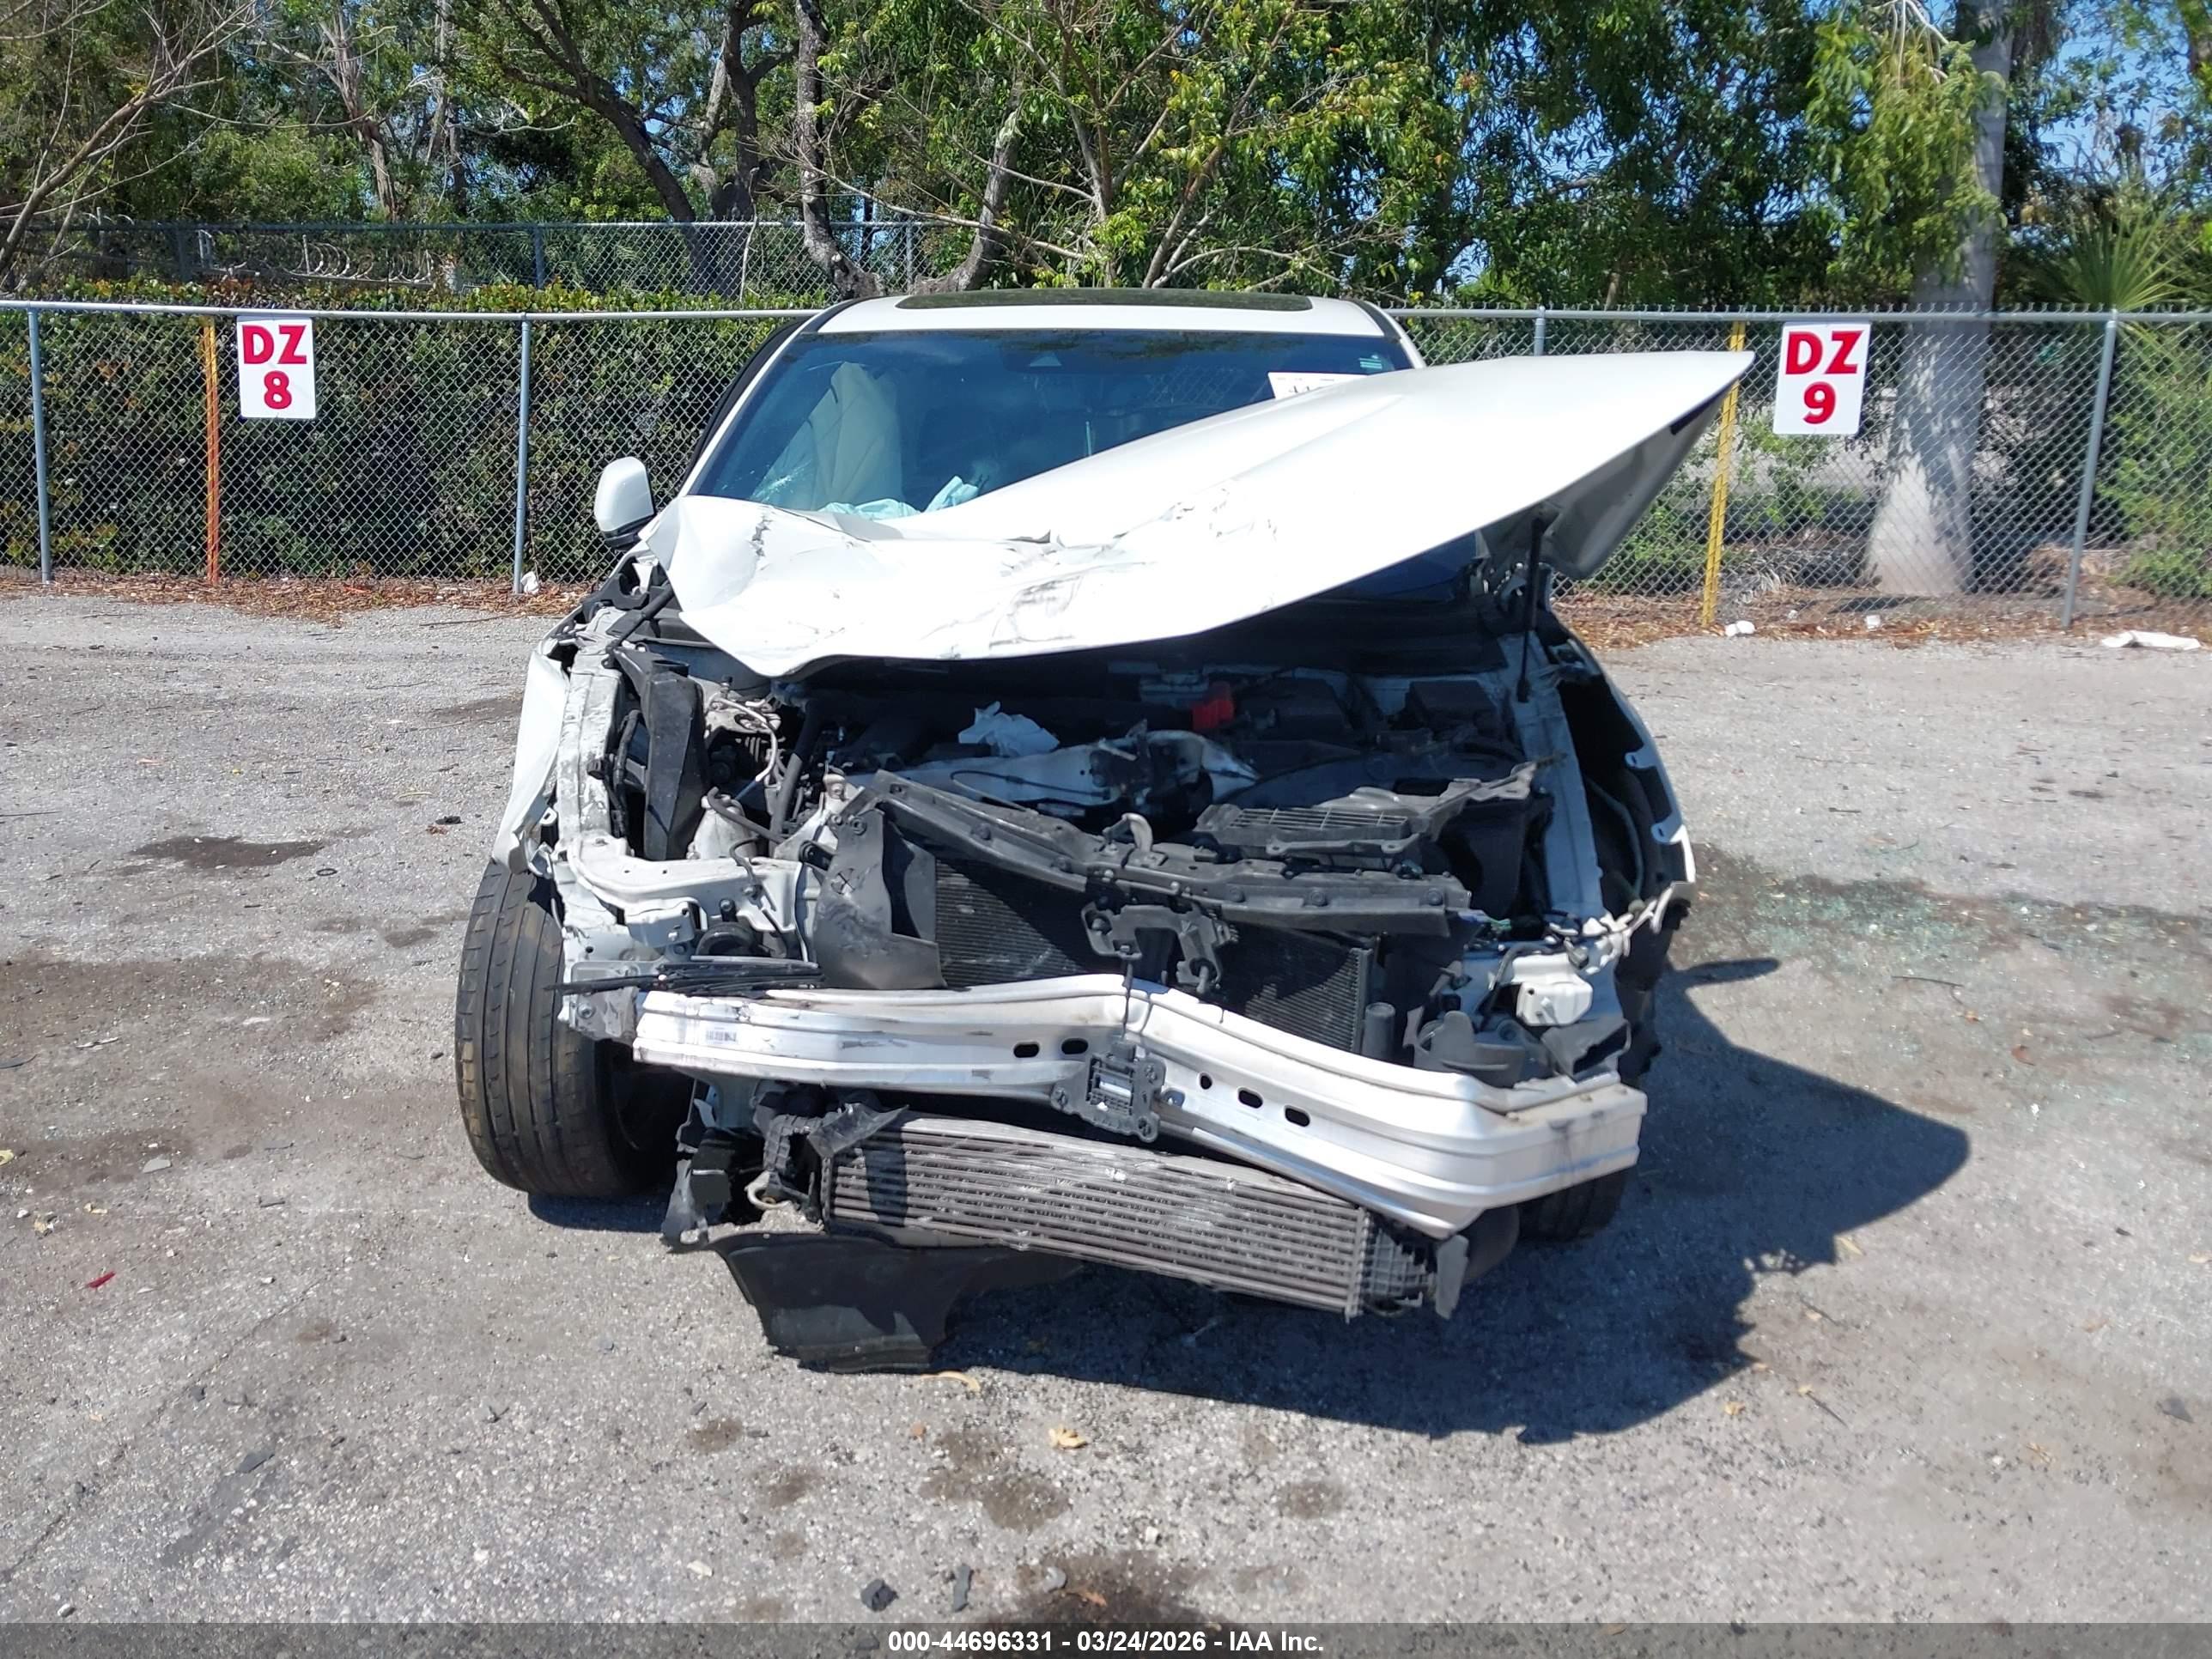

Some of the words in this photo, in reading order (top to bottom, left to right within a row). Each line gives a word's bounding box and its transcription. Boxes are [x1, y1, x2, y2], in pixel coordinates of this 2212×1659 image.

[241, 325, 307, 365] DZ
[1785, 330, 1863, 375] DZ
[264, 370, 293, 410] 8
[1802, 380, 1837, 425] 9
